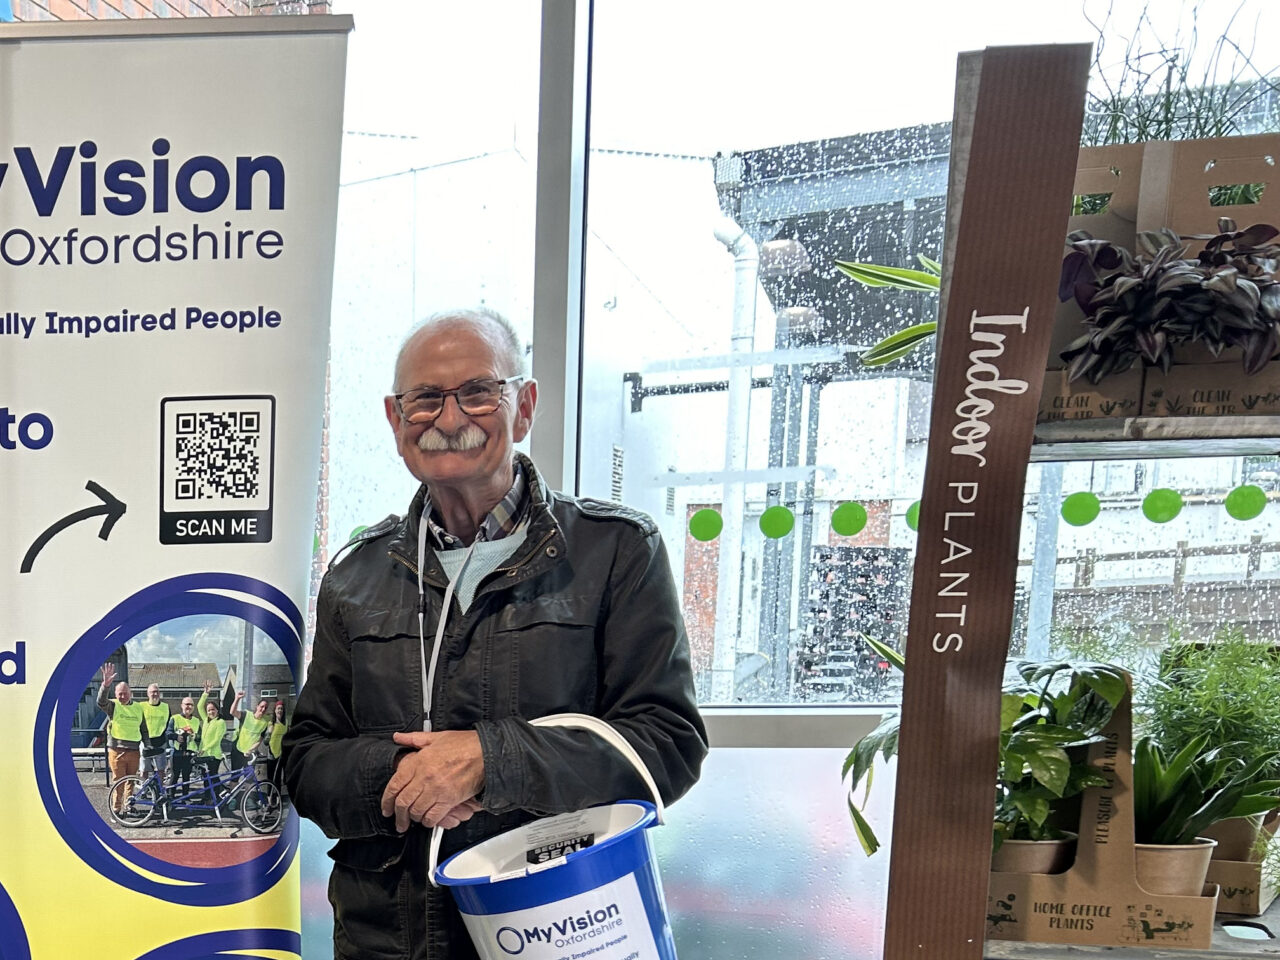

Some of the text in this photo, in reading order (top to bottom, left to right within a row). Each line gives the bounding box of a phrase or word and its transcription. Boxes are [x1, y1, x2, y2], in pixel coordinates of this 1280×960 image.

[0, 221, 284, 267] Oxfordshire
[44, 308, 176, 336] Impaired
[186, 306, 282, 332] People
[933, 306, 1030, 654] Indoor PLANTS
[175, 517, 258, 537] SCAN ME
[523, 903, 620, 944] MyVision
[1034, 902, 1113, 918] HOME OFFICE
[1048, 916, 1095, 931] PLANTS
[554, 917, 624, 948] Oxfordshire
